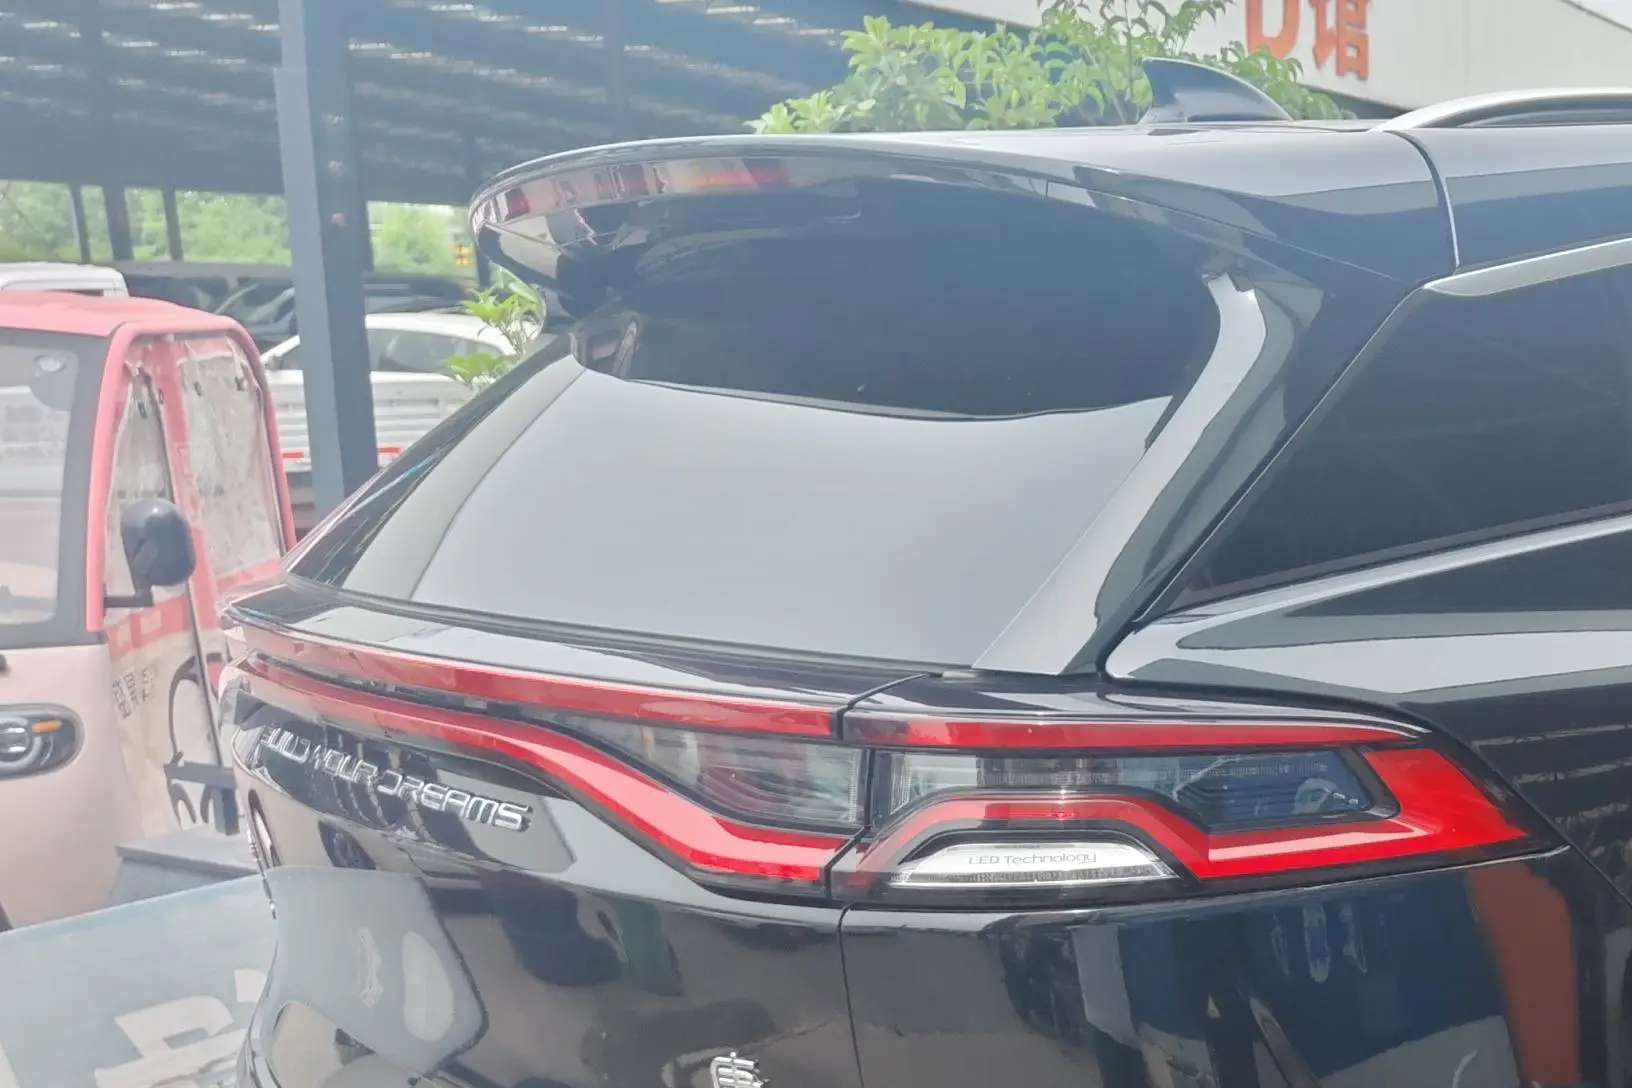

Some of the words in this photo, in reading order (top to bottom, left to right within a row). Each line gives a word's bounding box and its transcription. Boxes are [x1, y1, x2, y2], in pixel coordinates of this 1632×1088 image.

[377, 769, 530, 831] DREAMS
[969, 855, 999, 865] LED
[1004, 852, 1097, 864] Technology
